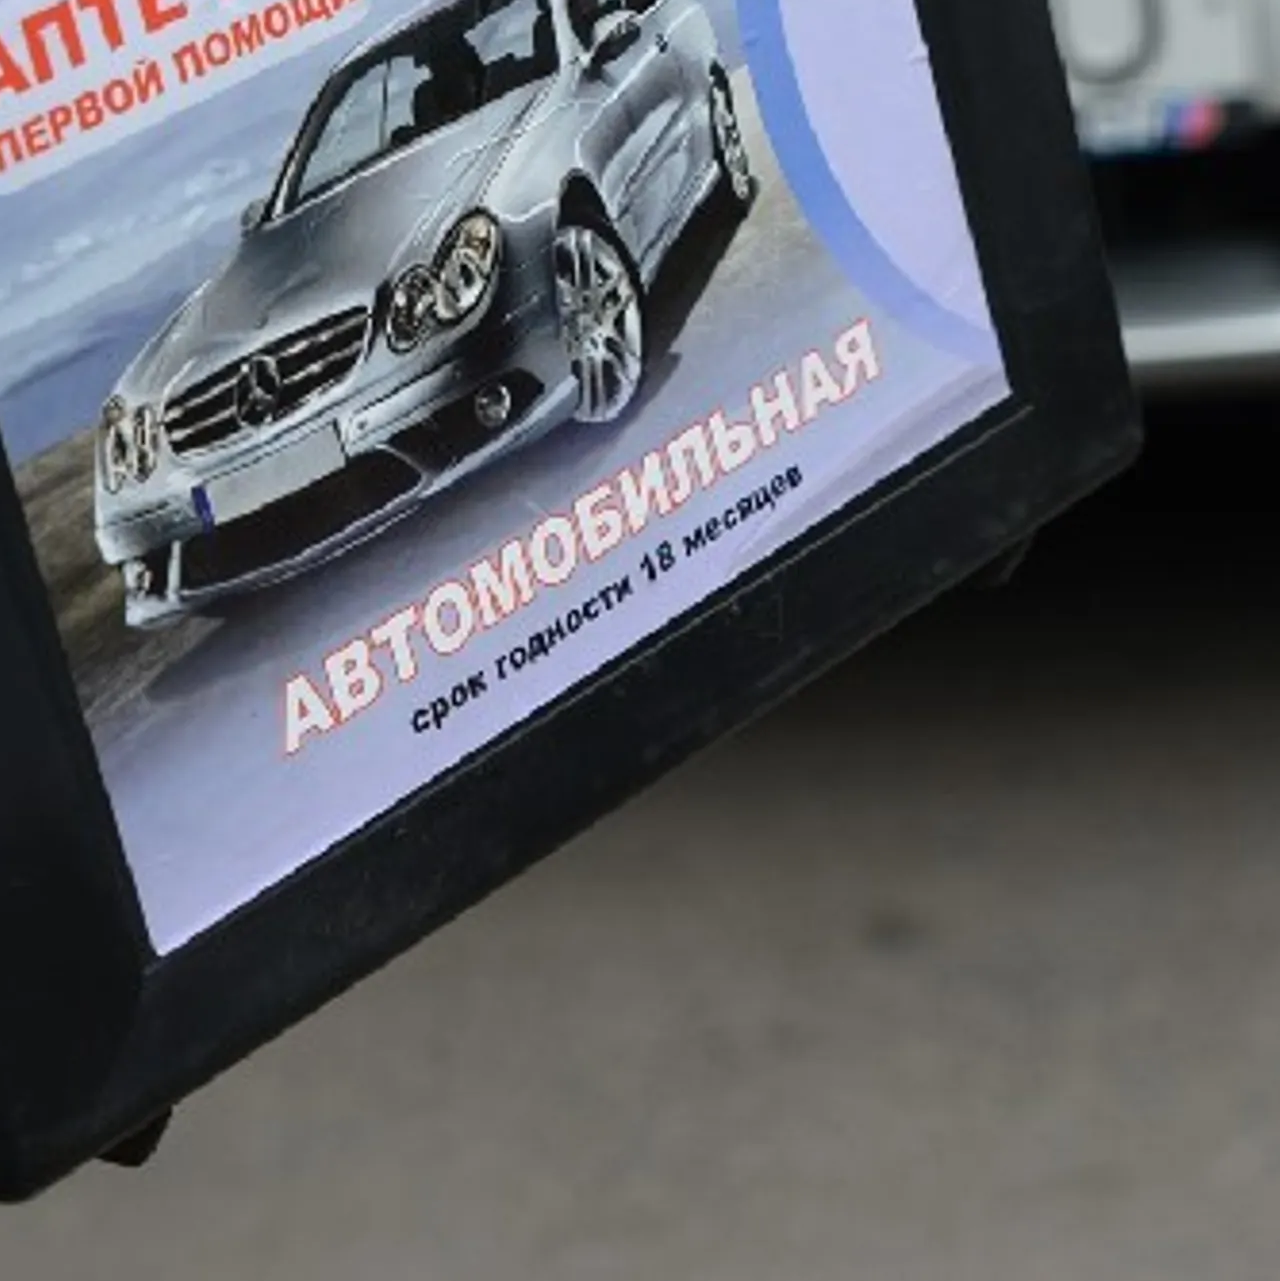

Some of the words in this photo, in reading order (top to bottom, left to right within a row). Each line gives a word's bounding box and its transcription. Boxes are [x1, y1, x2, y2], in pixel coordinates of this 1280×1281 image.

[281, 319, 882, 755] АВТОМОБИЛЬНАЯ
[410, 668, 489, 734] срок
[494, 579, 634, 681] годности
[639, 539, 678, 584] 18
[681, 463, 805, 558] месяцев
